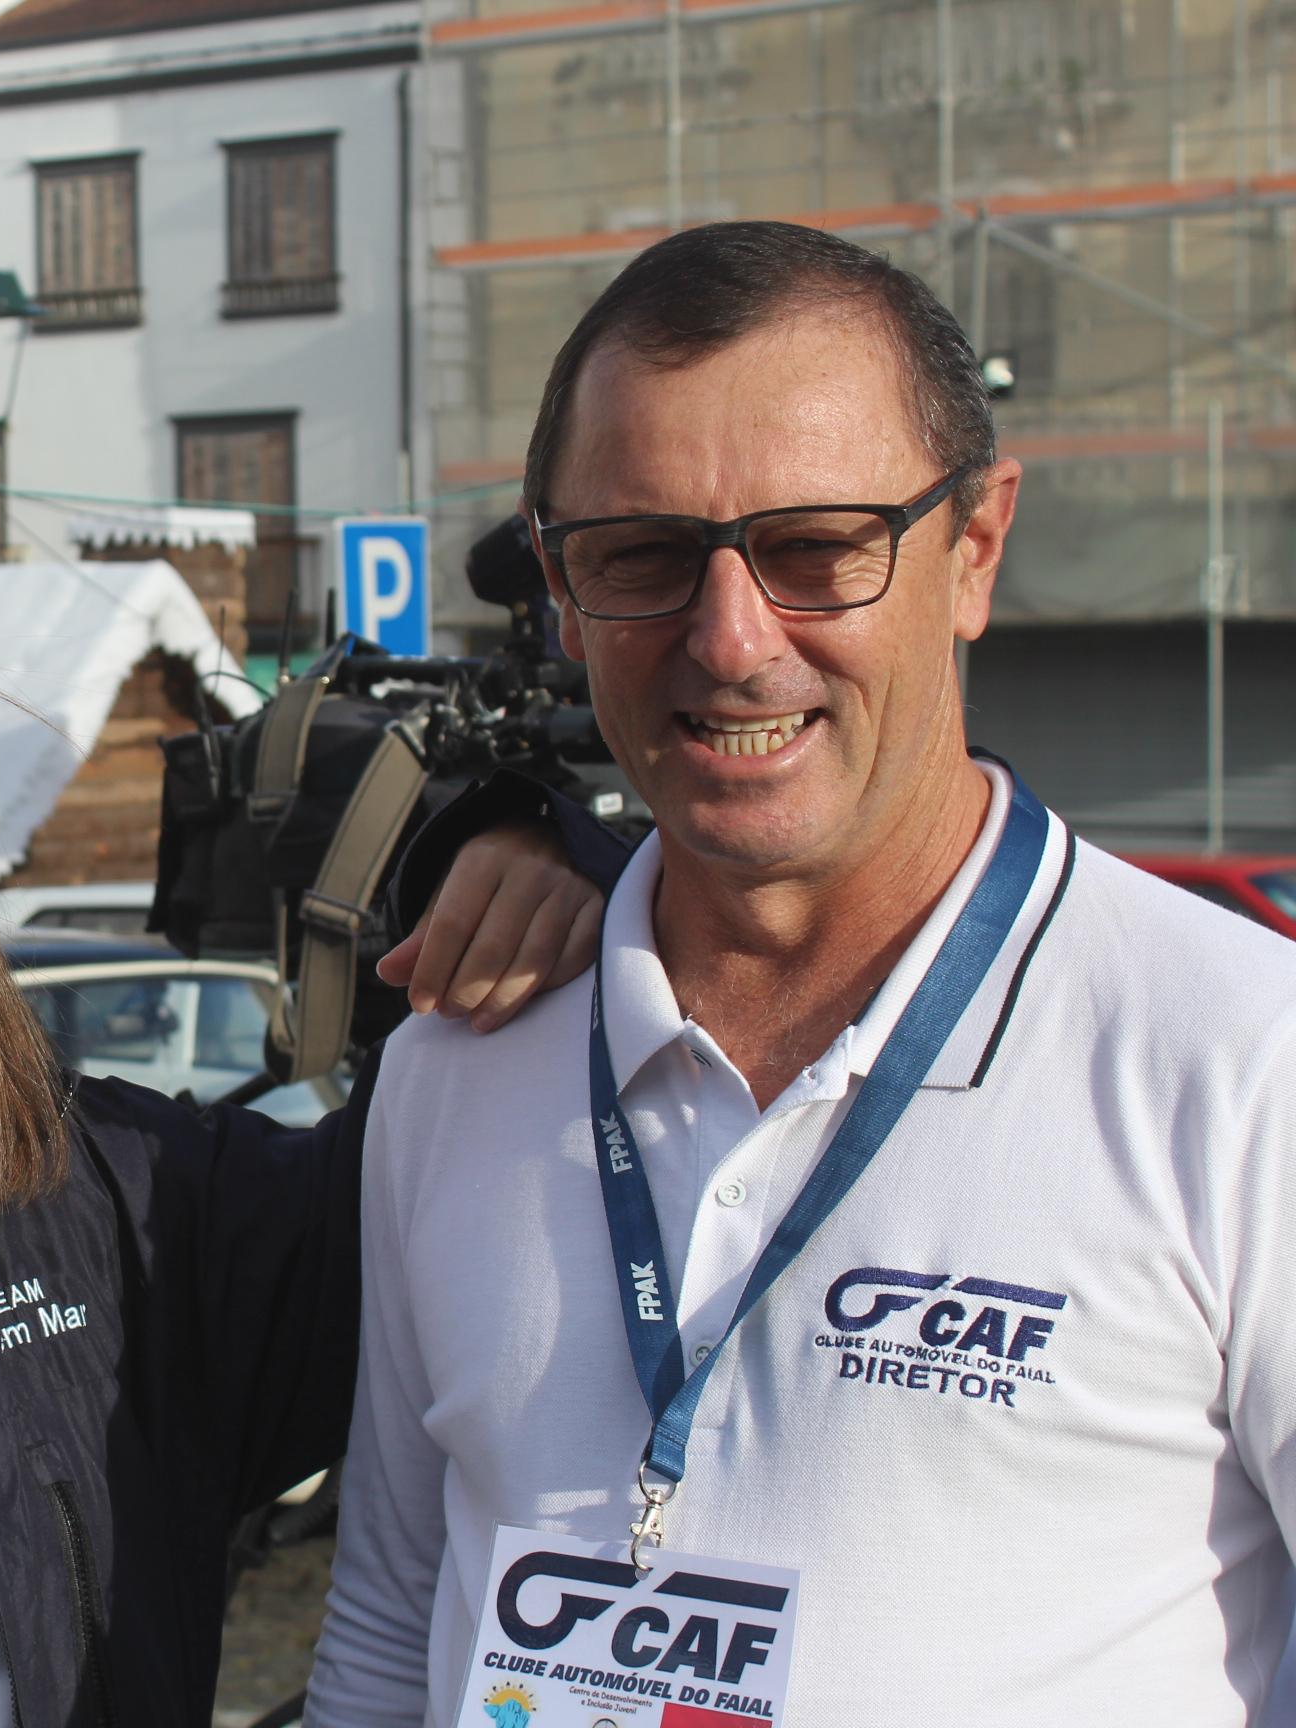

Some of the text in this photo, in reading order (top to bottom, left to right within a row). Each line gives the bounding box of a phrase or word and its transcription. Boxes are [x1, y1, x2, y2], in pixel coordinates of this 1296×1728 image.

[358, 537, 413, 643] P
[599, 1111, 633, 1174] FPAK
[630, 1259, 664, 1321] FPAK
[814, 1334, 1056, 1384] CLUBE AUTOMÓVEL DO FAIAL
[919, 1299, 1055, 1362] CAF
[839, 1352, 1016, 1408] DIRETOR
[611, 1605, 778, 1685] CAF
[483, 1651, 548, 1677] CLUBE
[550, 1664, 673, 1700] AUTOMÓVEL
[678, 1684, 710, 1705] DO
[713, 1692, 774, 1717] FAIAL
[569, 1686, 653, 1708] Centro de Desenvolvimento
[587, 1699, 613, 1711] Inclusão
[614, 1703, 637, 1715] Juvenil
